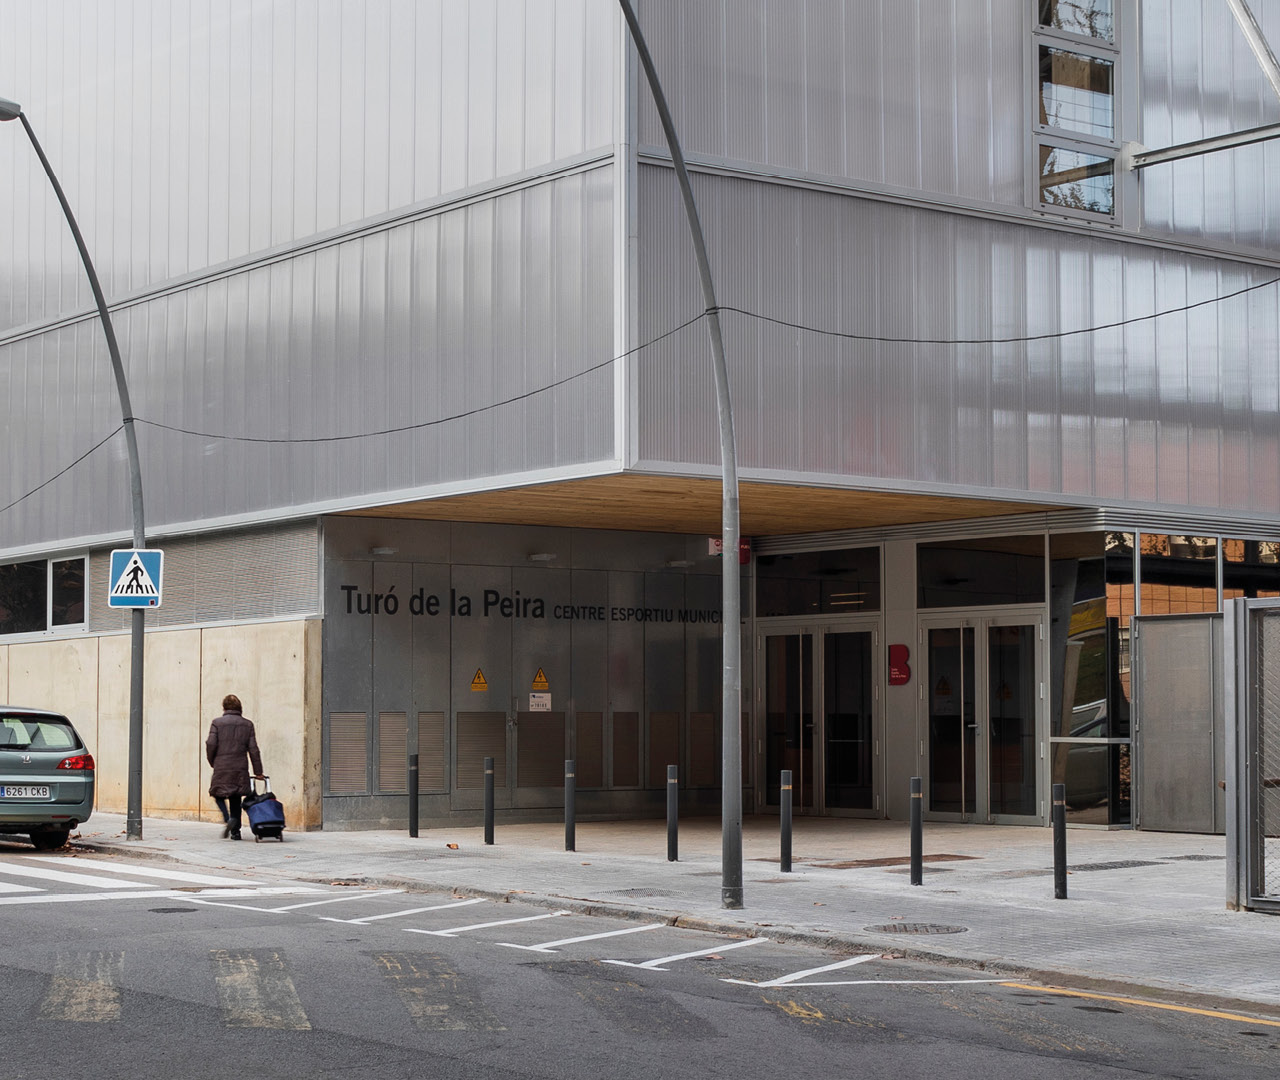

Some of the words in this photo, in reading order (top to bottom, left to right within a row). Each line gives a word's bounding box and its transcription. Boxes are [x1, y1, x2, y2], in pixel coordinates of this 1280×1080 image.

[341, 585, 399, 615] Turó
[409, 587, 440, 616] de
[450, 588, 471, 617] la
[483, 589, 545, 619] Peira
[554, 605, 605, 620] CENTRE
[611, 606, 674, 623] ESPORTIU
[6, 787, 28, 796] 6261
[31, 787, 48, 796] CKB
